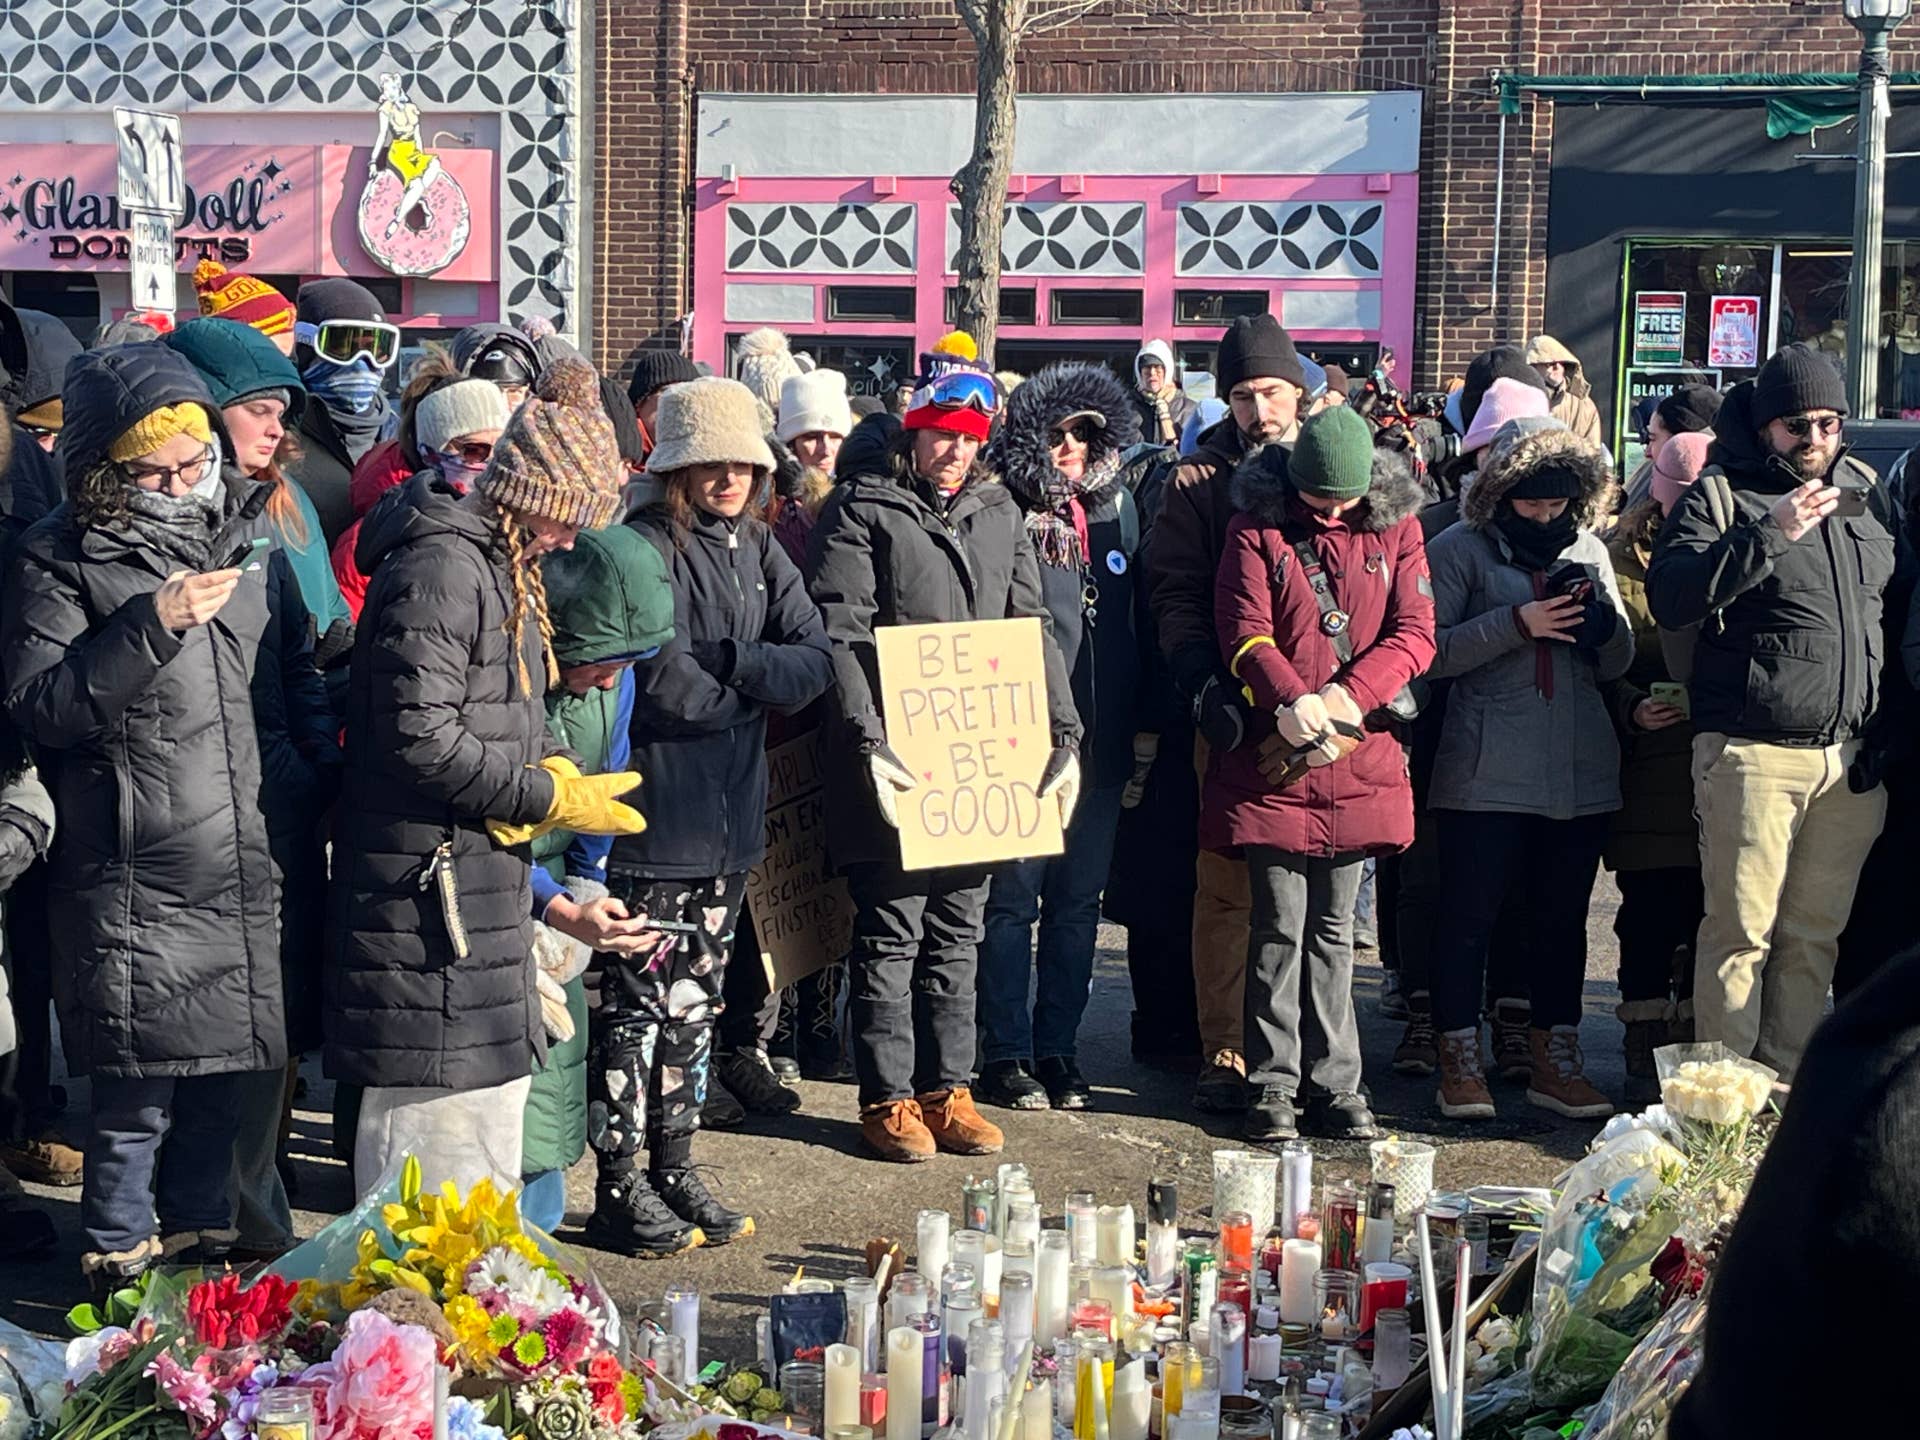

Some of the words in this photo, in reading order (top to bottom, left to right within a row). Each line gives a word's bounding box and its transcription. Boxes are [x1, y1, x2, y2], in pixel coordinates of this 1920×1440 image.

[122, 178, 149, 199] ONLY
[137, 222, 170, 239] TRUCK
[137, 247, 170, 265] ROUTE
[1640, 314, 1681, 332] FREE
[1633, 384, 1674, 397] BLACK
[918, 633, 973, 678] BE
[899, 681, 1037, 736] PRETTI
[949, 739, 1004, 784] BE
[920, 782, 1041, 838] GOOD
[761, 894, 837, 946] FINSTAD
